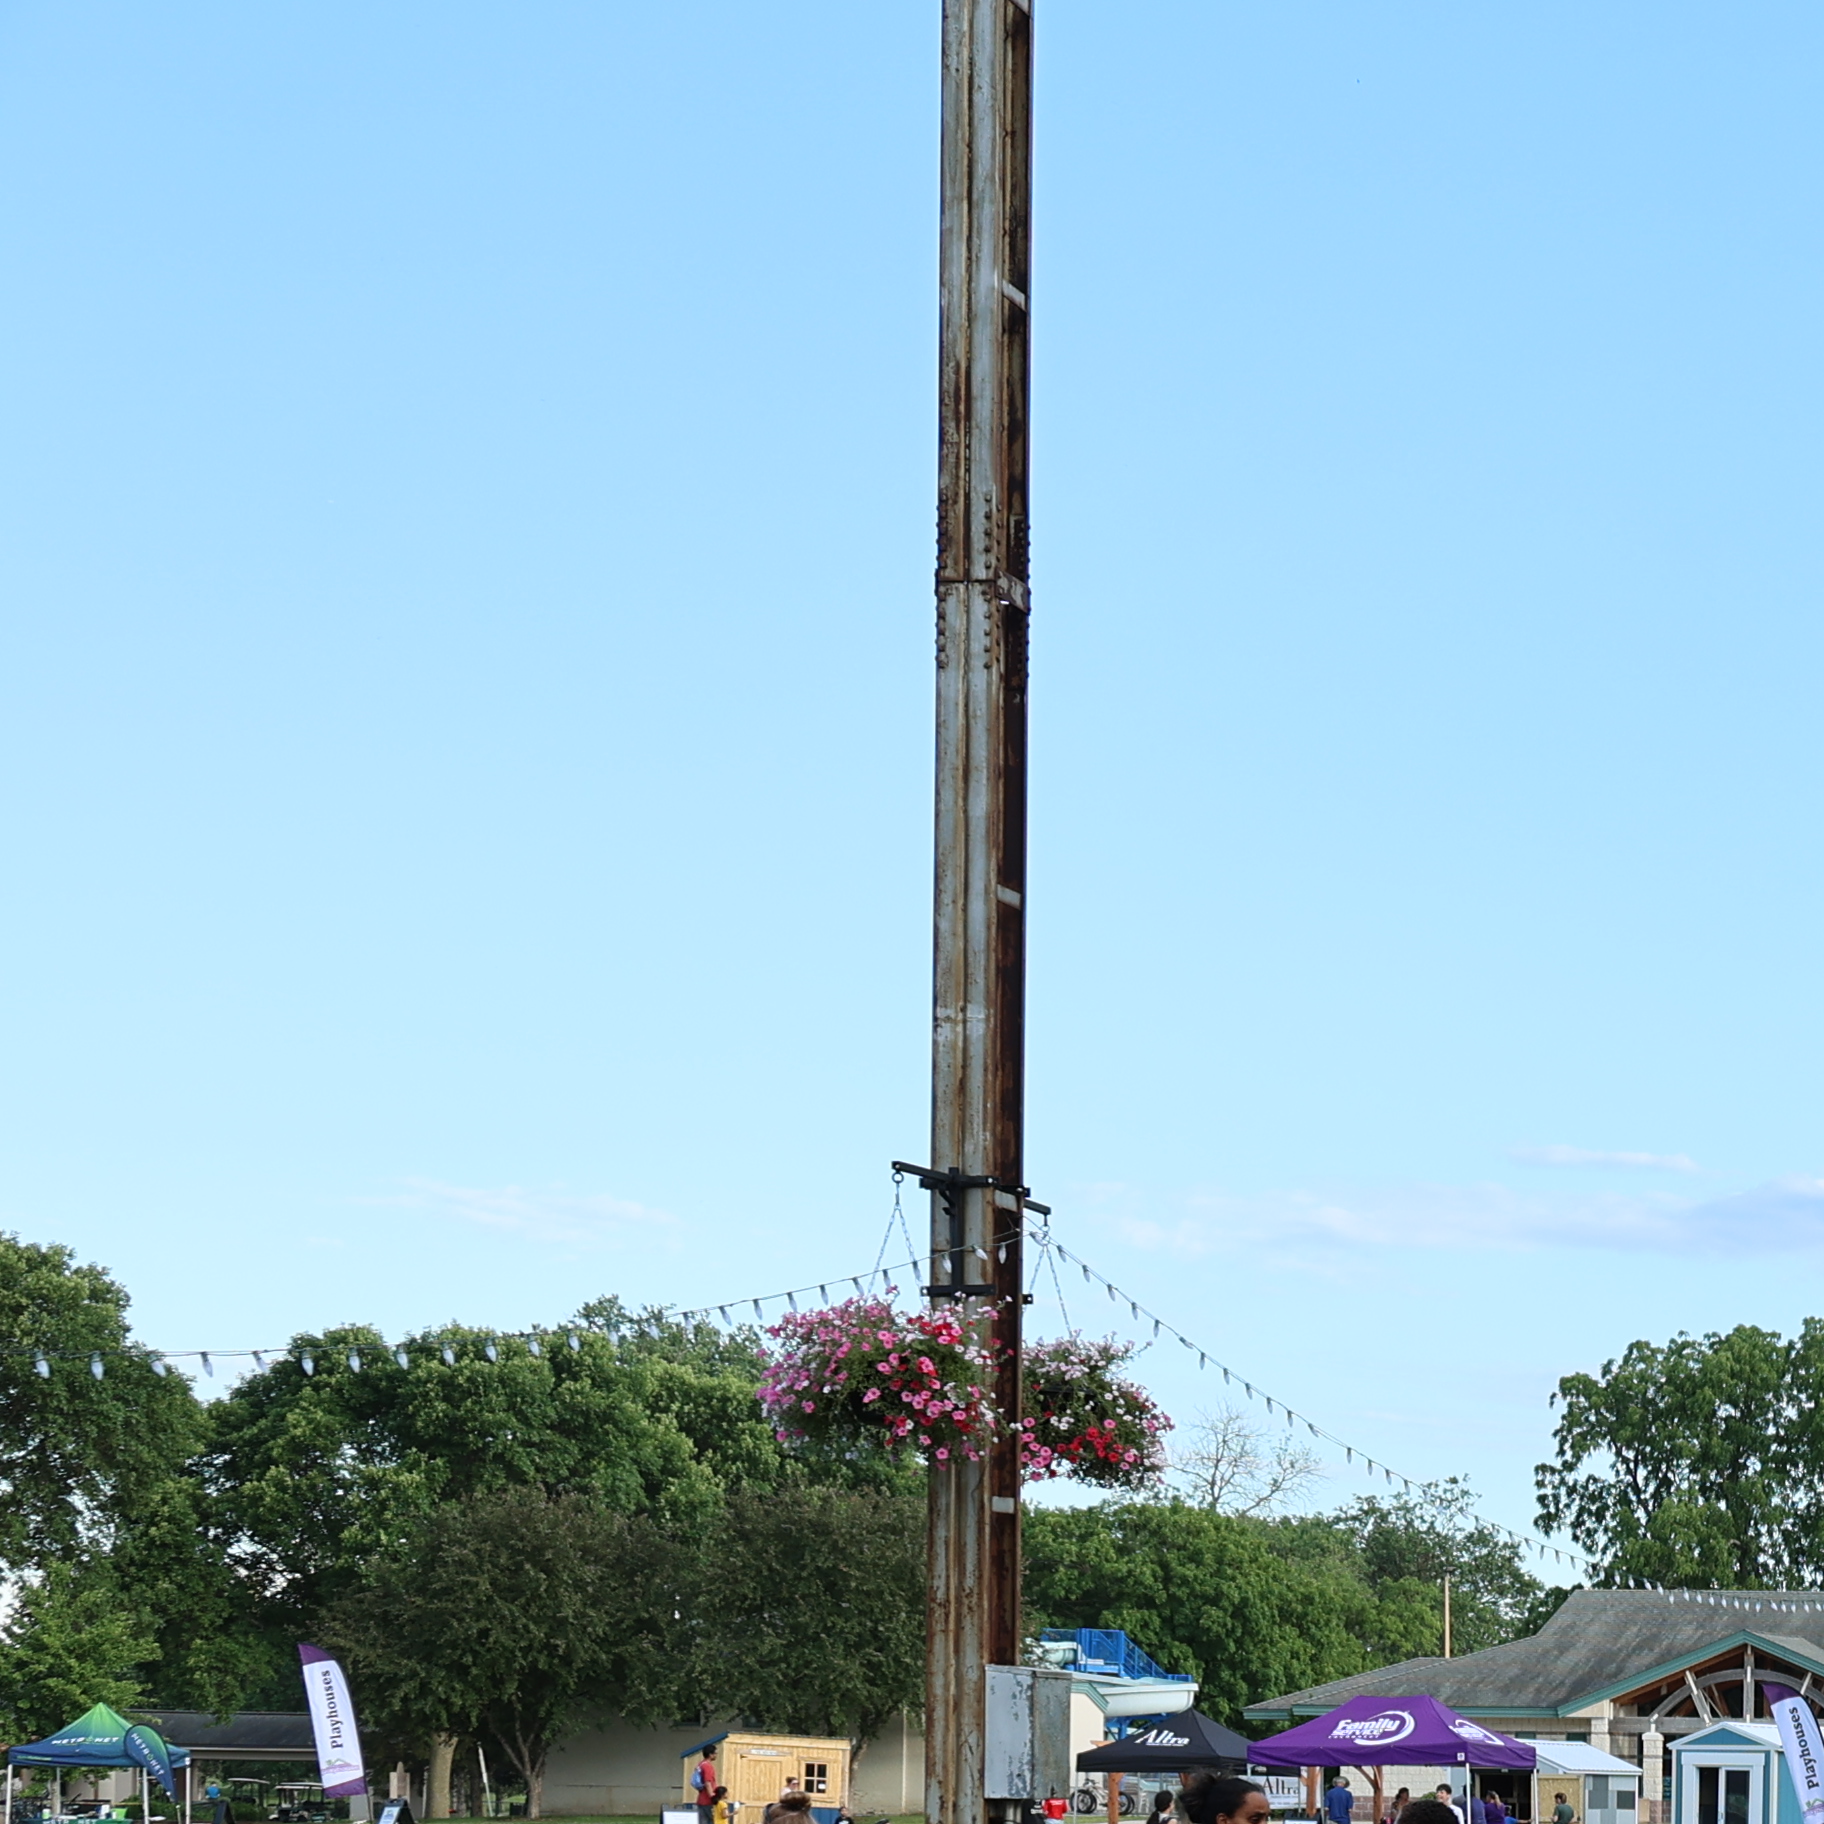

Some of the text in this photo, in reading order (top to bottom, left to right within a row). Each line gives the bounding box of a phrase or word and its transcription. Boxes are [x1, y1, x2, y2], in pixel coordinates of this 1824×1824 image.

[321, 1670, 344, 1749] Playhouses
[1338, 1718, 1400, 1731] Family
[1135, 1729, 1190, 1745] Altra
[1789, 1707, 1819, 1790] Playhouses
